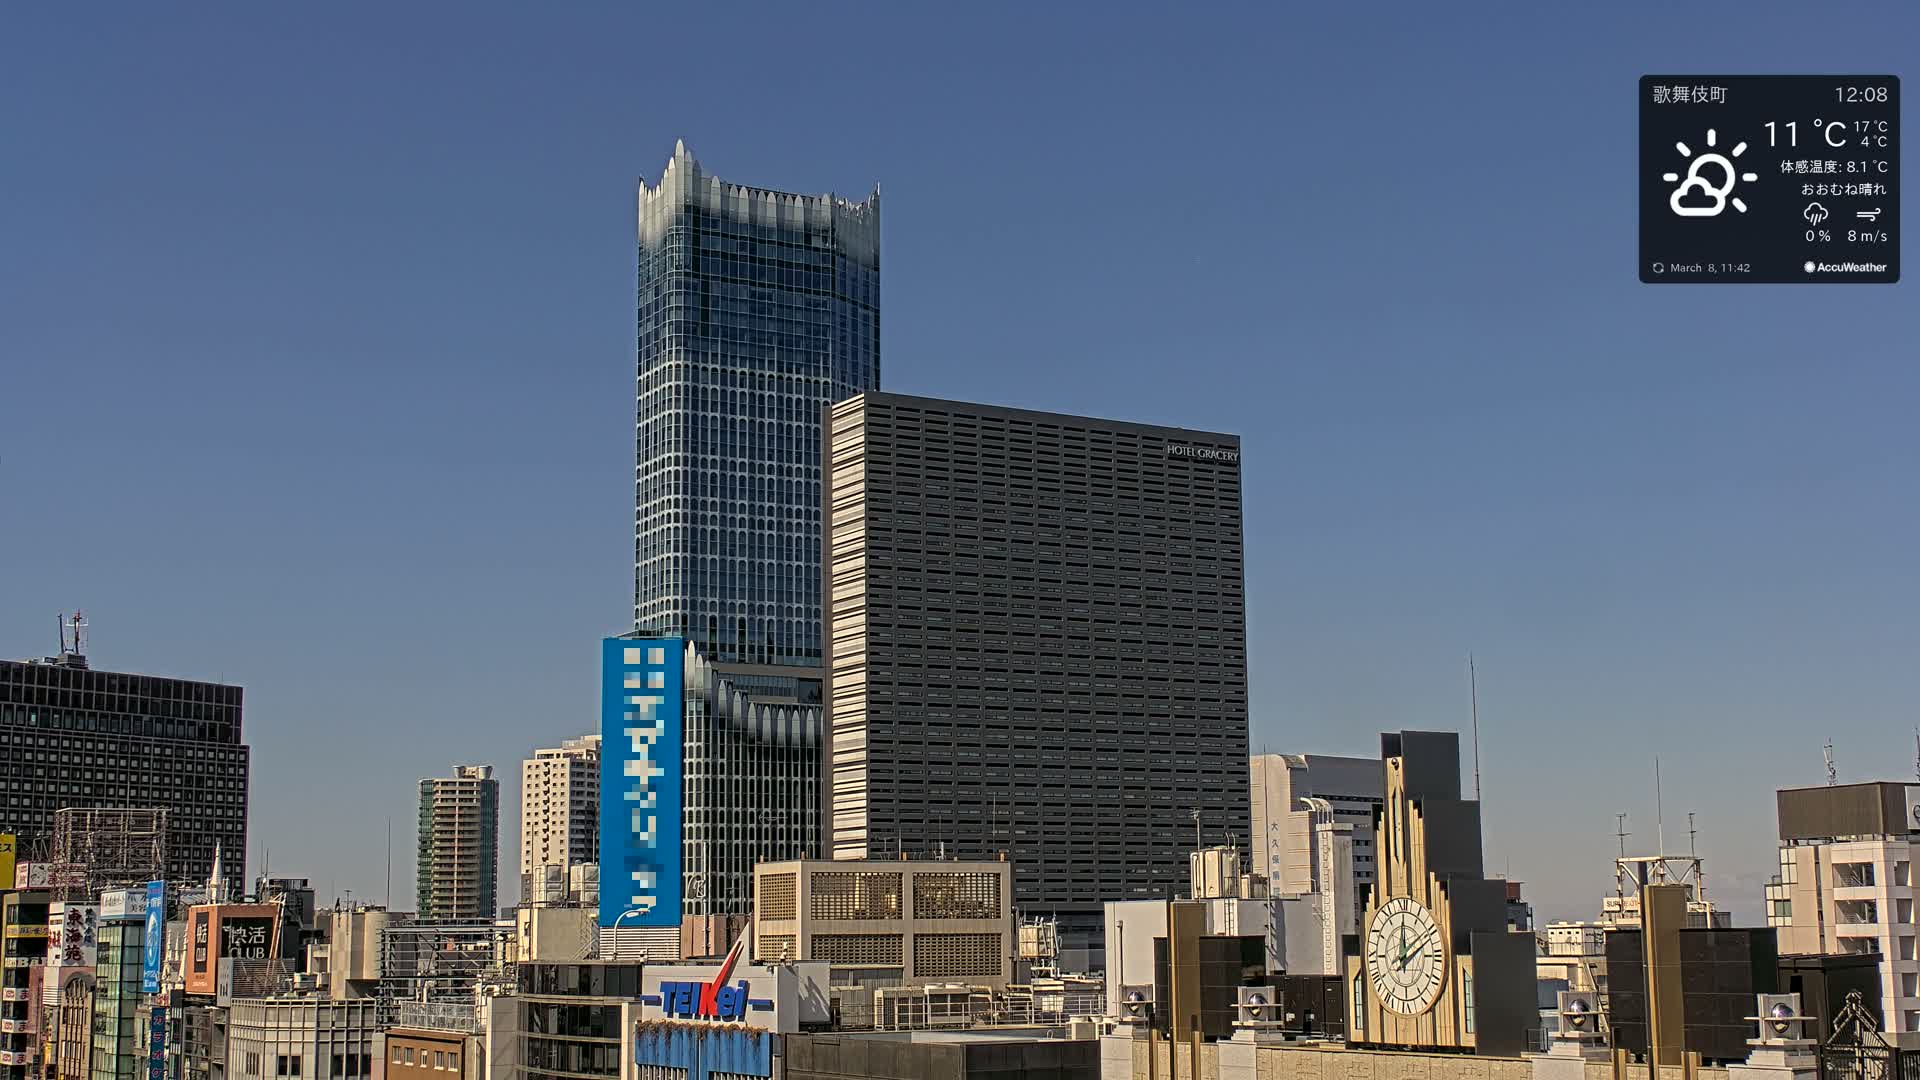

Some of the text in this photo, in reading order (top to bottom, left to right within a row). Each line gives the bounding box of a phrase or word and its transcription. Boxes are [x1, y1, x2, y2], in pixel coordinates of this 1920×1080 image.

[1167, 444, 1239, 461] HOTEL GRACERY
[64, 907, 83, 961] 東海苑
[231, 926, 266, 944] 快活
[231, 947, 265, 959] CLUB
[152, 1015, 164, 1078] カラオケ
